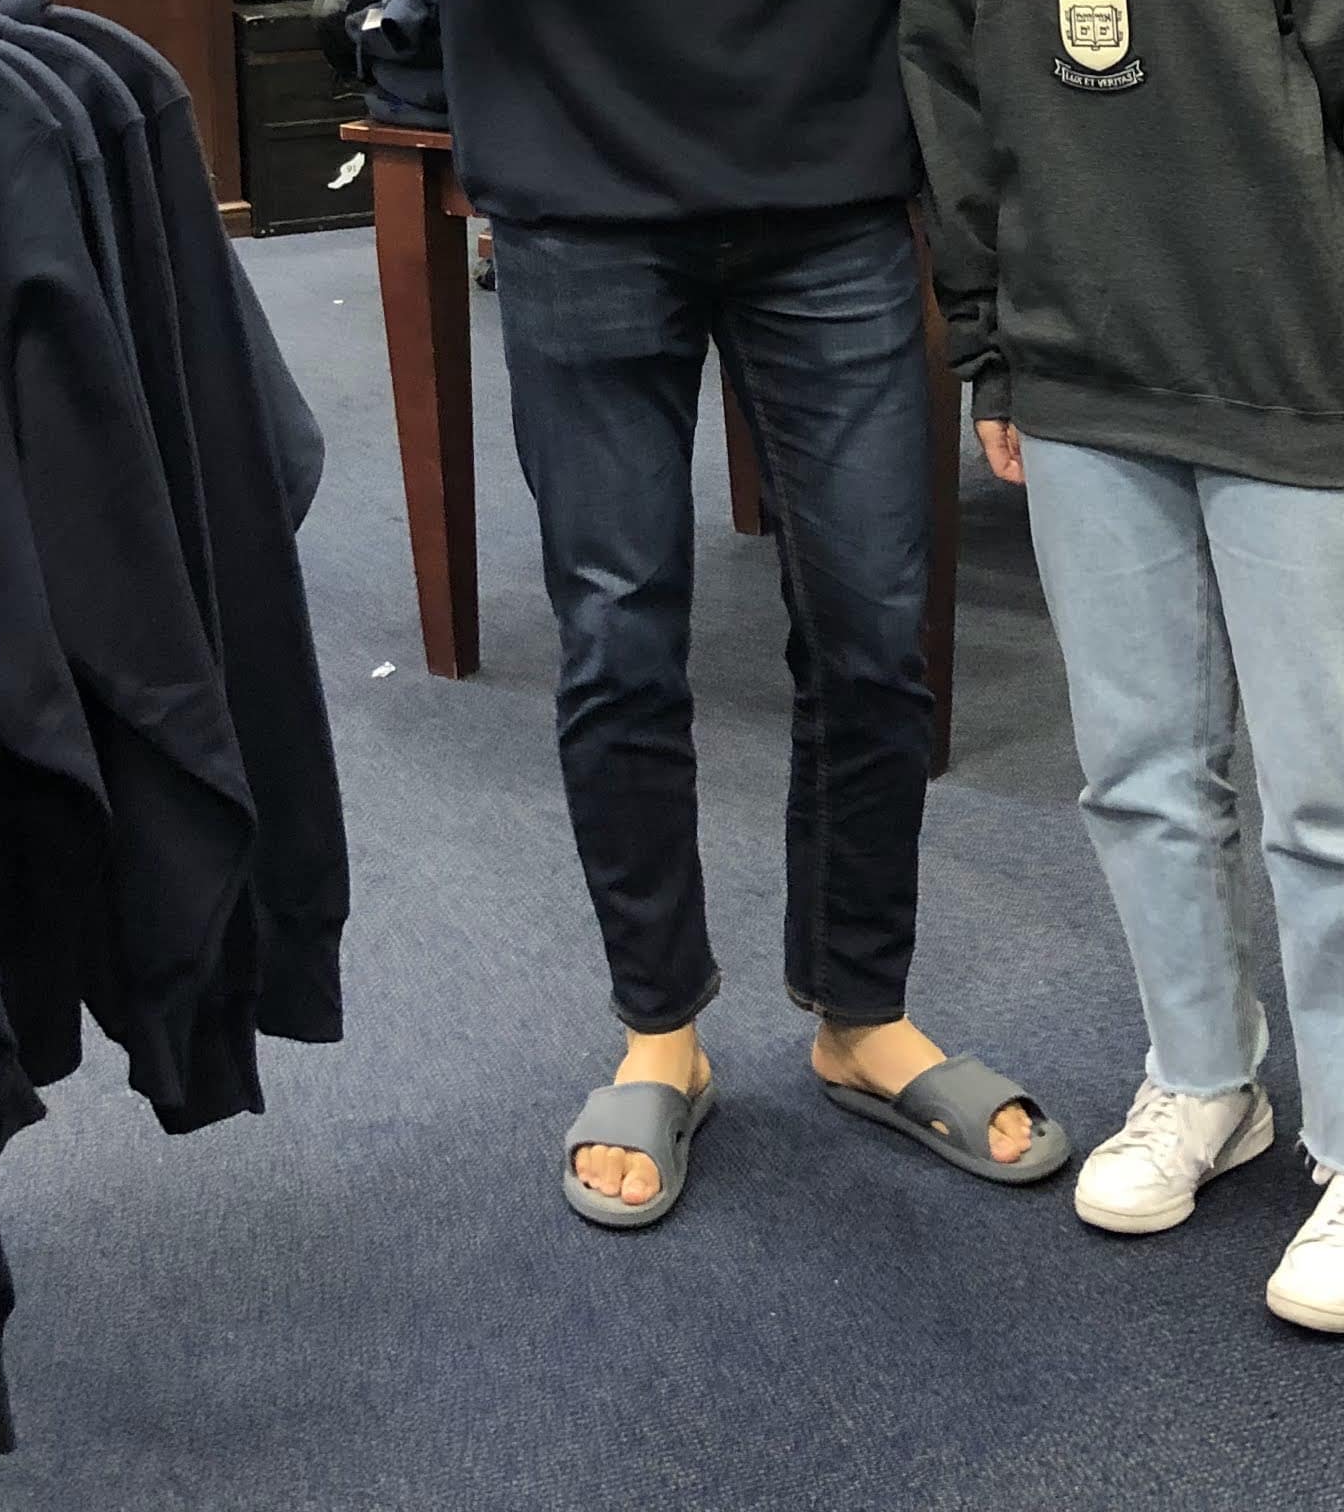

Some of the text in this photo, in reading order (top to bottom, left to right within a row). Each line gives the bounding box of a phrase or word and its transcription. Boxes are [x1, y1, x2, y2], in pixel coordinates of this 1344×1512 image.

[1065, 71, 1134, 88] LUX ET VERITAS
